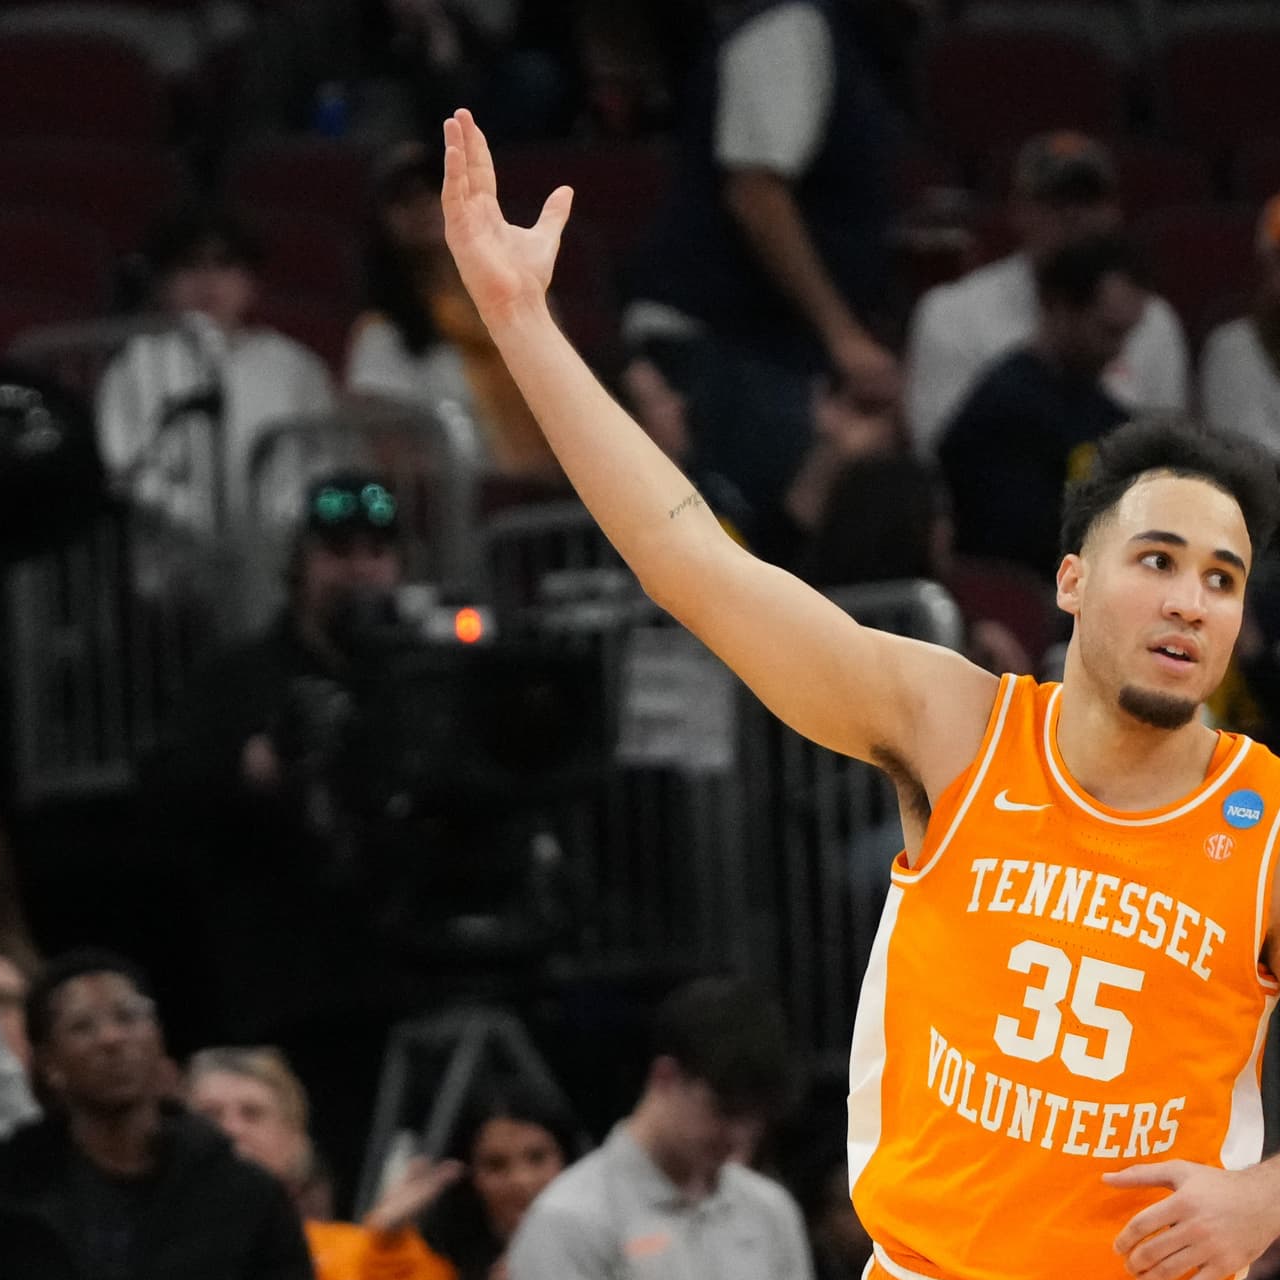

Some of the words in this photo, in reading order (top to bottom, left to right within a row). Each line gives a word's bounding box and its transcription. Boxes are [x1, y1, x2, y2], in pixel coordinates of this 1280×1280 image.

[1226, 804, 1260, 820] NCAA
[966, 857, 1226, 981] TENNESSEE
[993, 939, 1145, 1082] 35
[926, 1025, 1186, 1159] VOLUNTEERS
